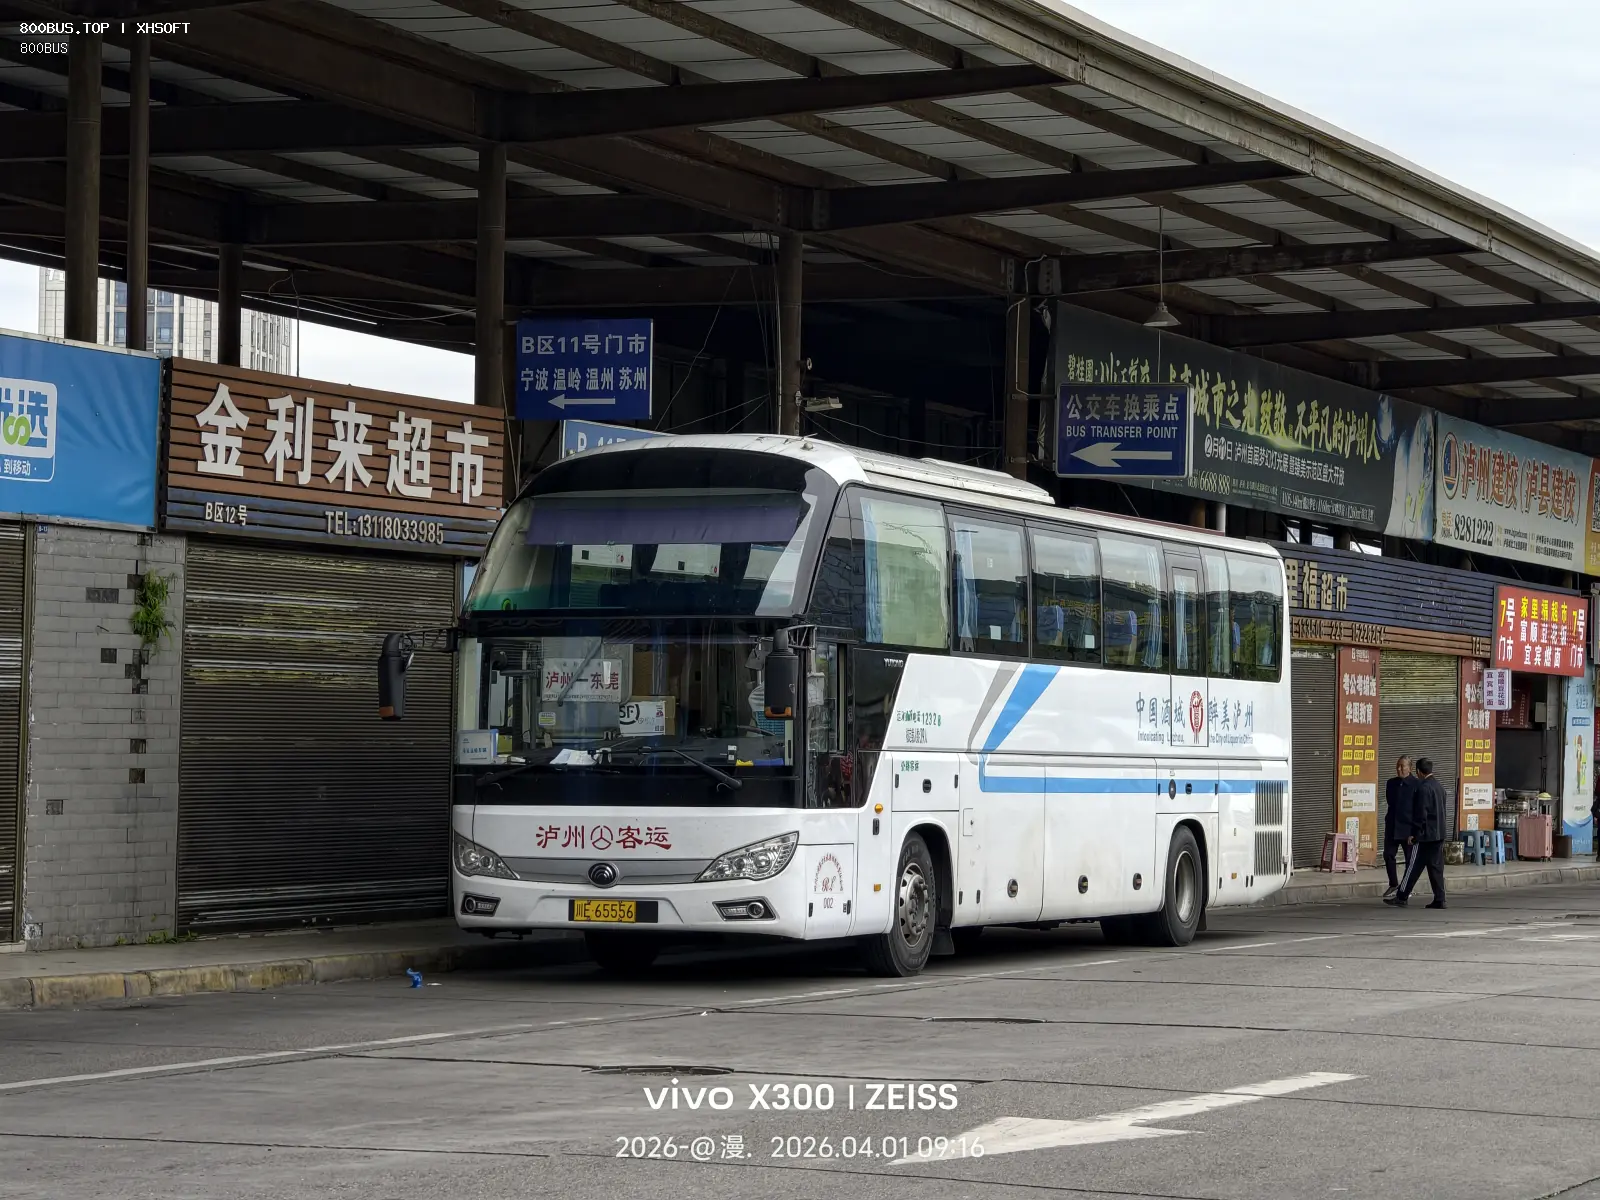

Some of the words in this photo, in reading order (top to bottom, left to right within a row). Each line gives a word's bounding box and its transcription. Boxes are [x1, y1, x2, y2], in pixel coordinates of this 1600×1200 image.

[521, 333, 647, 355] B区11号门市
[520, 367, 549, 391] 宁波
[553, 367, 582, 391] 温岭
[585, 367, 614, 391] 温州
[618, 366, 647, 391] 苏州
[1066, 393, 1180, 421] 公交车换乘点
[195, 381, 489, 504] 金利来超市
[1066, 425, 1086, 438] BUS
[1091, 425, 1142, 439] TRANSFER
[1146, 426, 1178, 439] POINT
[204, 501, 248, 526] B区12号
[1453, 513, 1494, 547] 8281222
[1500, 597, 1516, 632] 7号
[1520, 596, 1568, 624] 家里福超市
[1498, 635, 1514, 662] 门市
[1136, 691, 1186, 729] 中国酒城
[535, 825, 585, 850] 泸州
[615, 825, 673, 850] 客运
